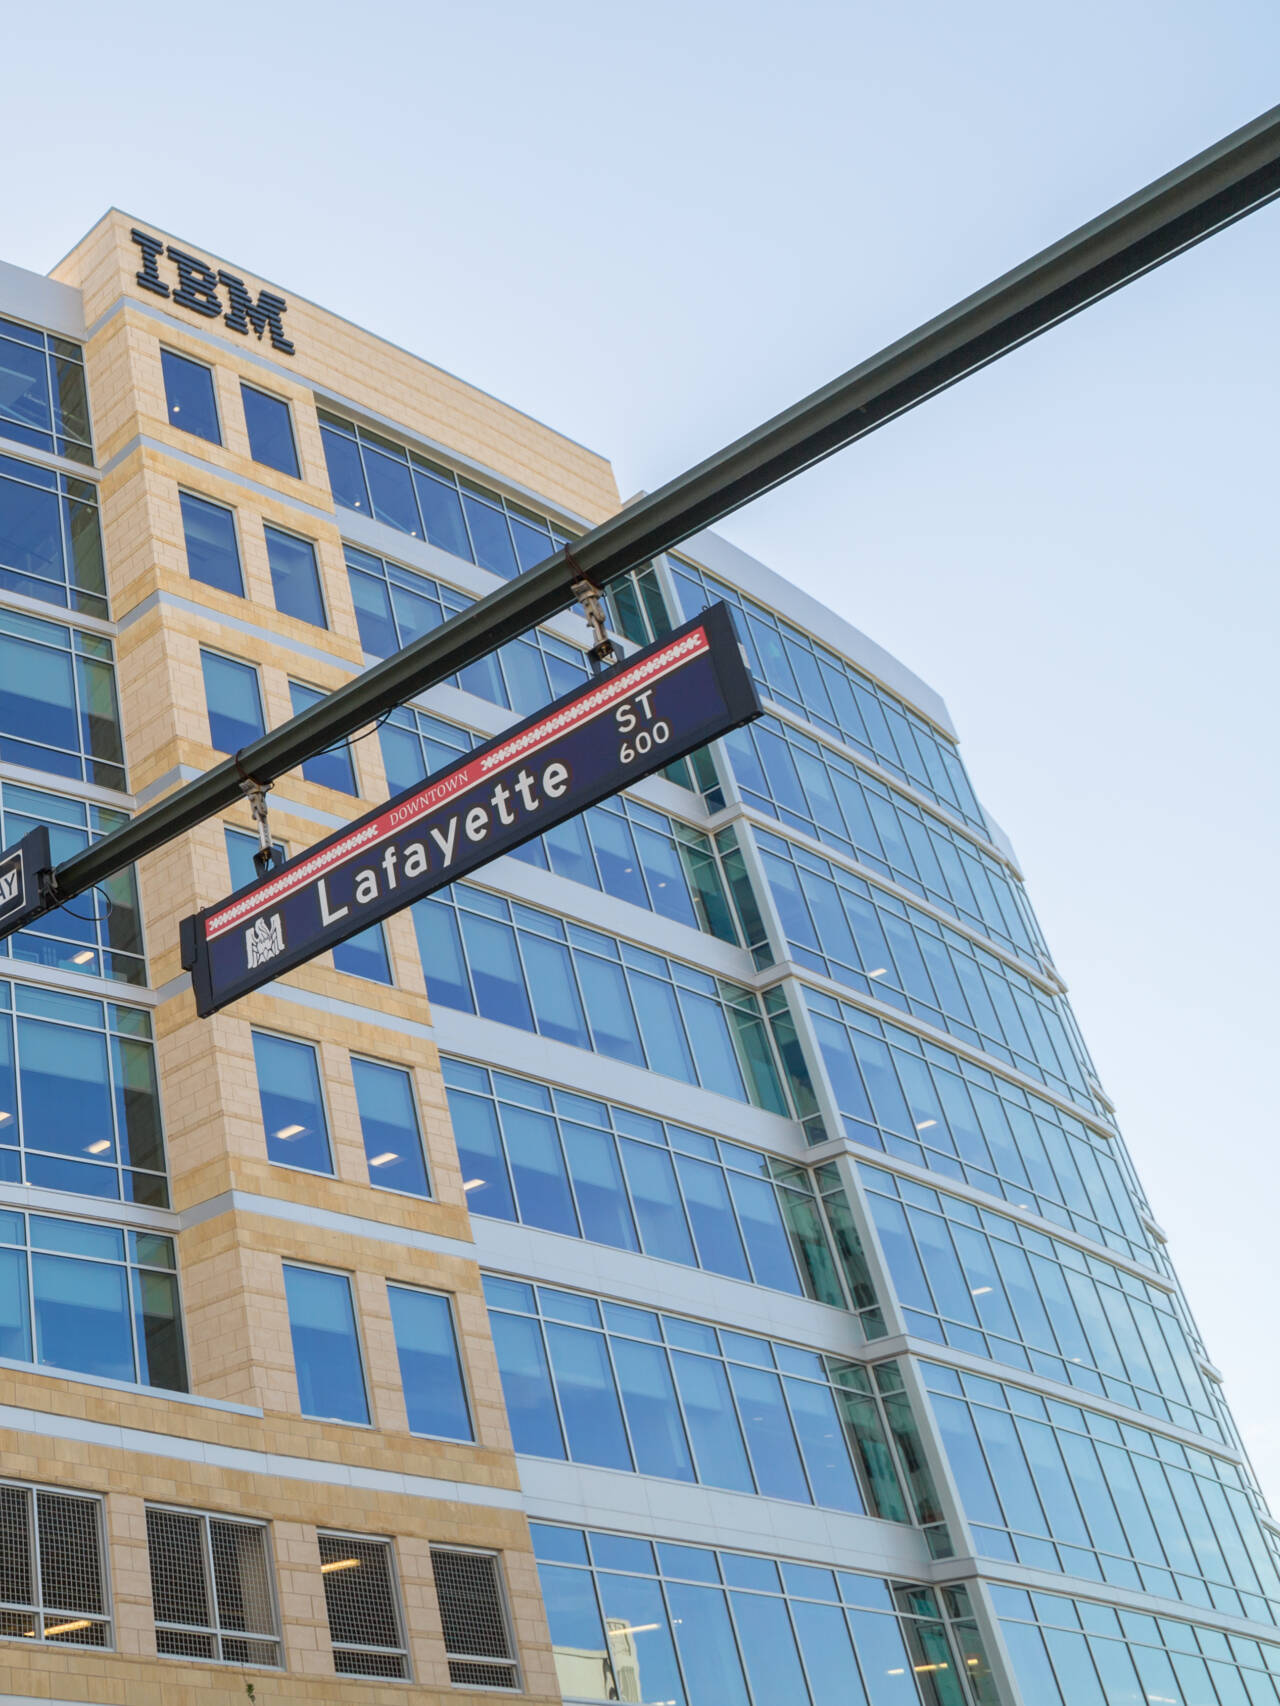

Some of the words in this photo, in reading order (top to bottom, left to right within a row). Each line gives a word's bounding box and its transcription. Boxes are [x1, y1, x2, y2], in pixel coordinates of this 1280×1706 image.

[131, 228, 295, 356] IBM
[620, 721, 669, 764] 600
[317, 762, 569, 927] Lafayette
[615, 689, 653, 733] ST
[389, 770, 469, 826] DOWNTOWN
